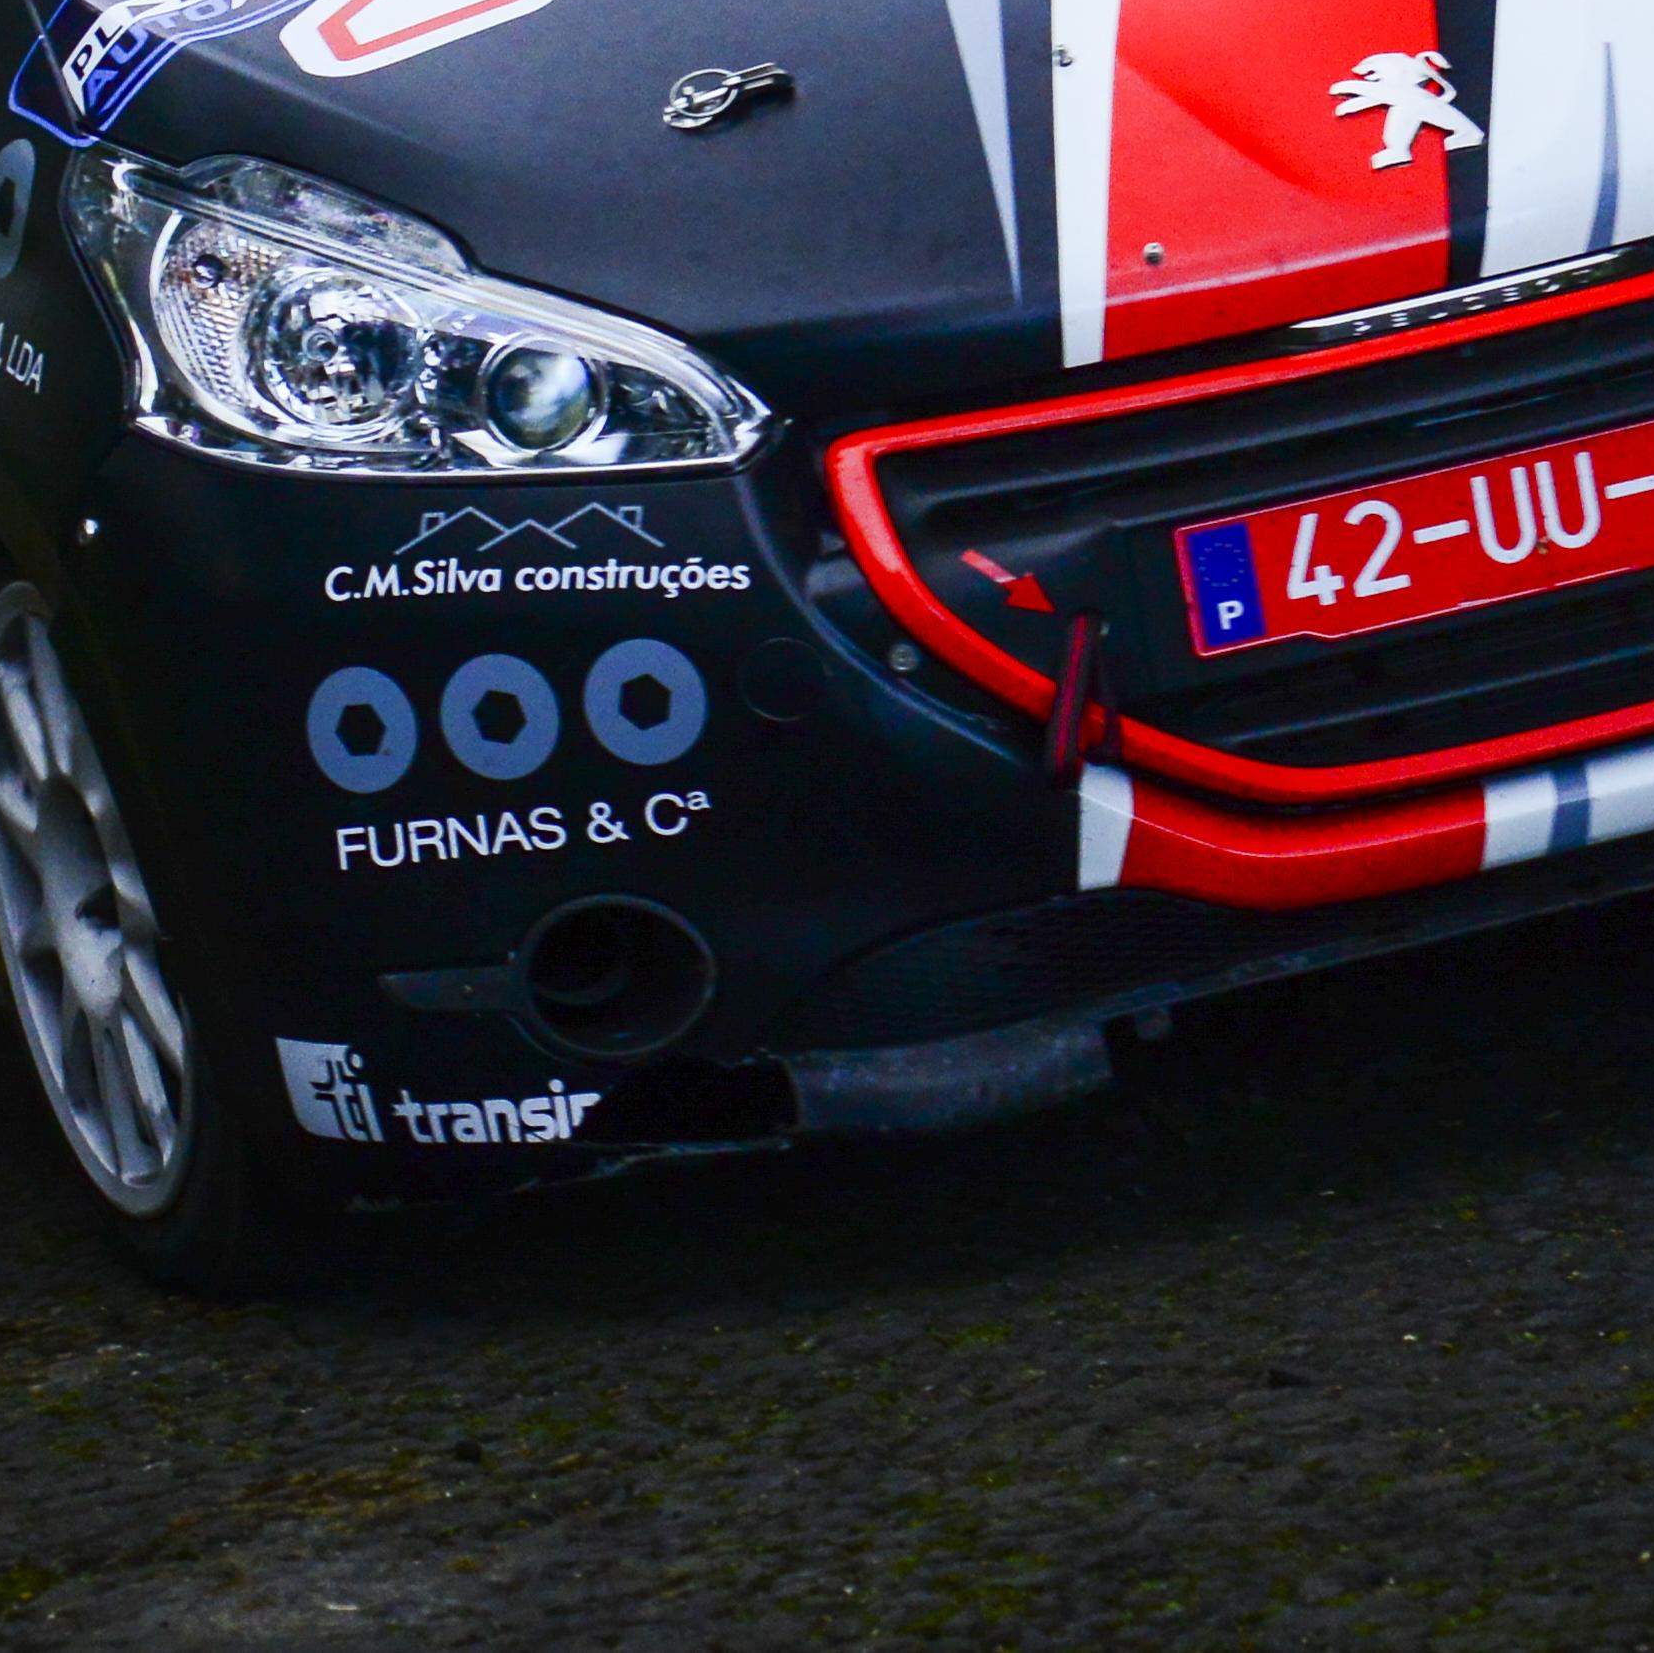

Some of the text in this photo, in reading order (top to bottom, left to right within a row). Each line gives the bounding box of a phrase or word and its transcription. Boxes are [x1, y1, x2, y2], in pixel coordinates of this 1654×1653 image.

[7, 333, 45, 394] LDA
[324, 556, 751, 603] C.M.Silva construções
[1217, 601, 1243, 632] P
[335, 805, 568, 871] FURNAS
[586, 801, 630, 844] &
